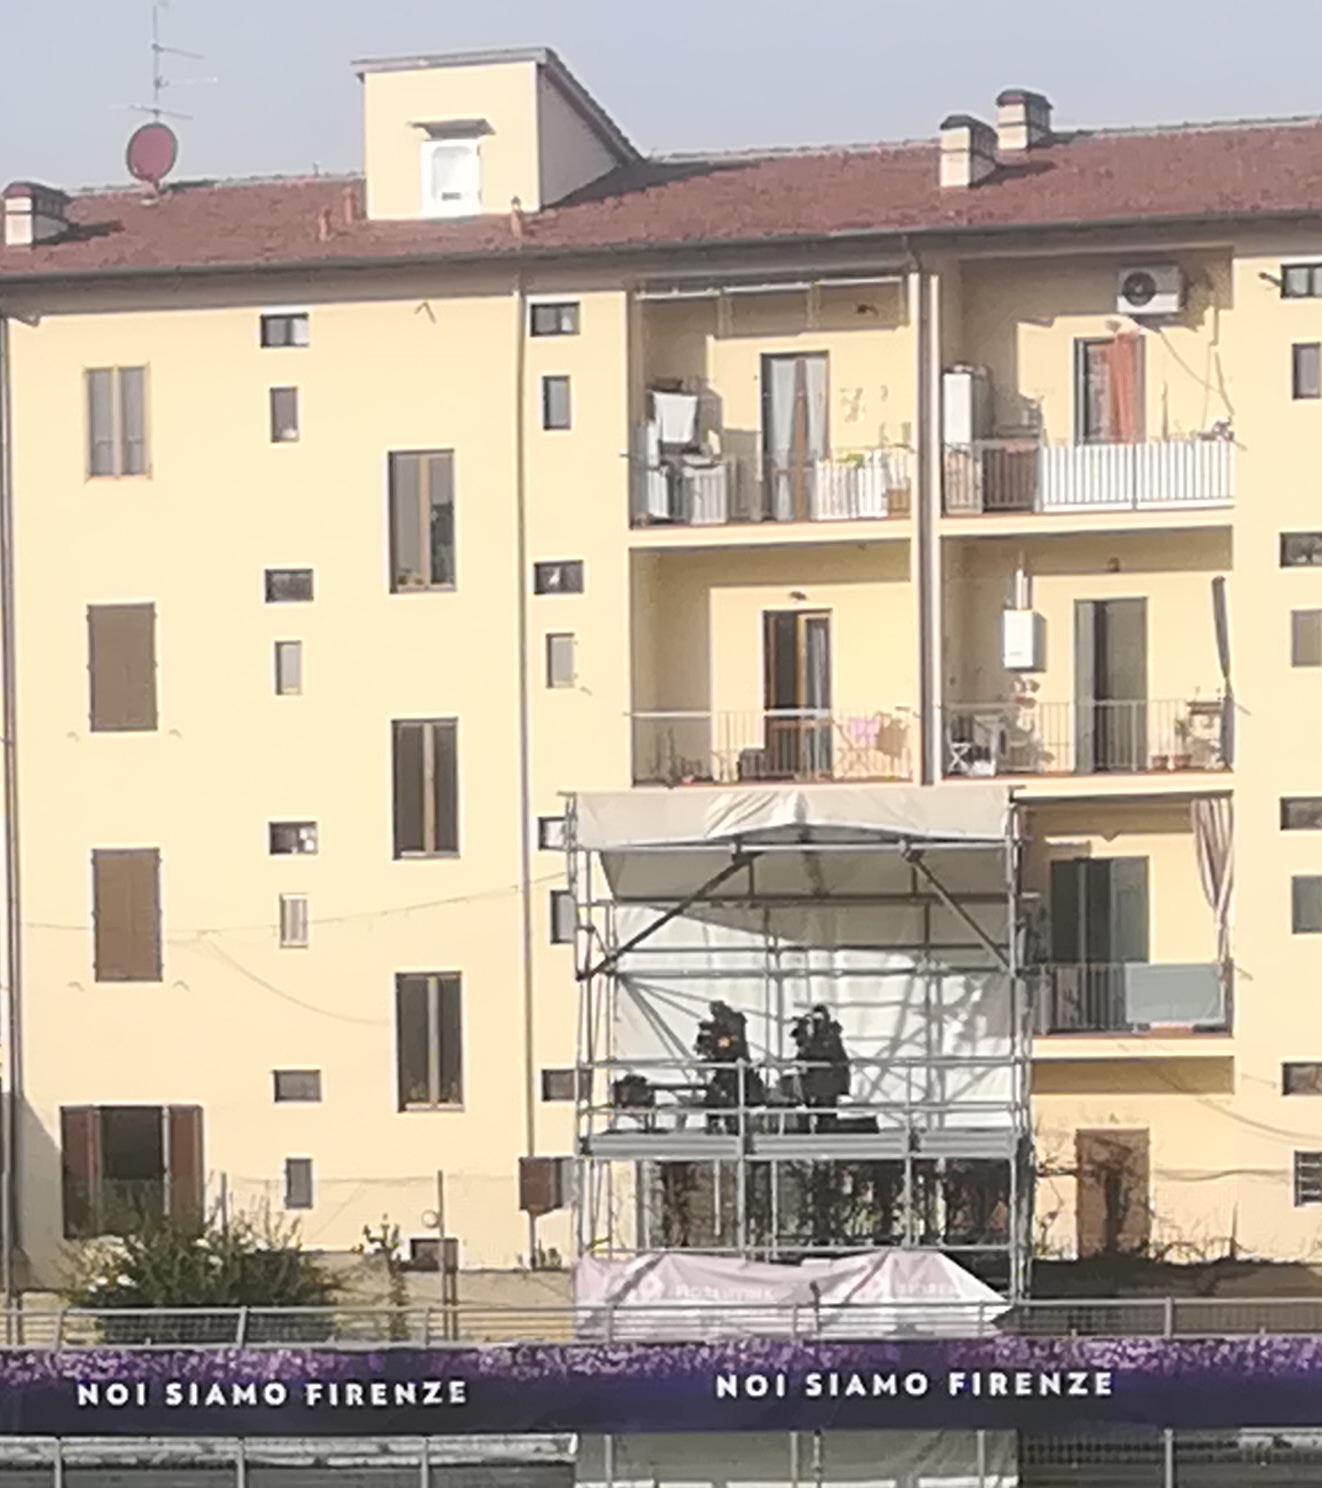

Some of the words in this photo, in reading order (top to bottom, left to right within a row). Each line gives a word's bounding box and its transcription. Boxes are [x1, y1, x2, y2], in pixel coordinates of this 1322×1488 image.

[77, 1382, 146, 1406] NOI
[165, 1381, 287, 1405] SIAMO
[305, 1381, 467, 1405] FIRENZE
[716, 1373, 785, 1398] NOI
[805, 1372, 928, 1397] SIAMO
[949, 1372, 1112, 1396] FIRENZE
